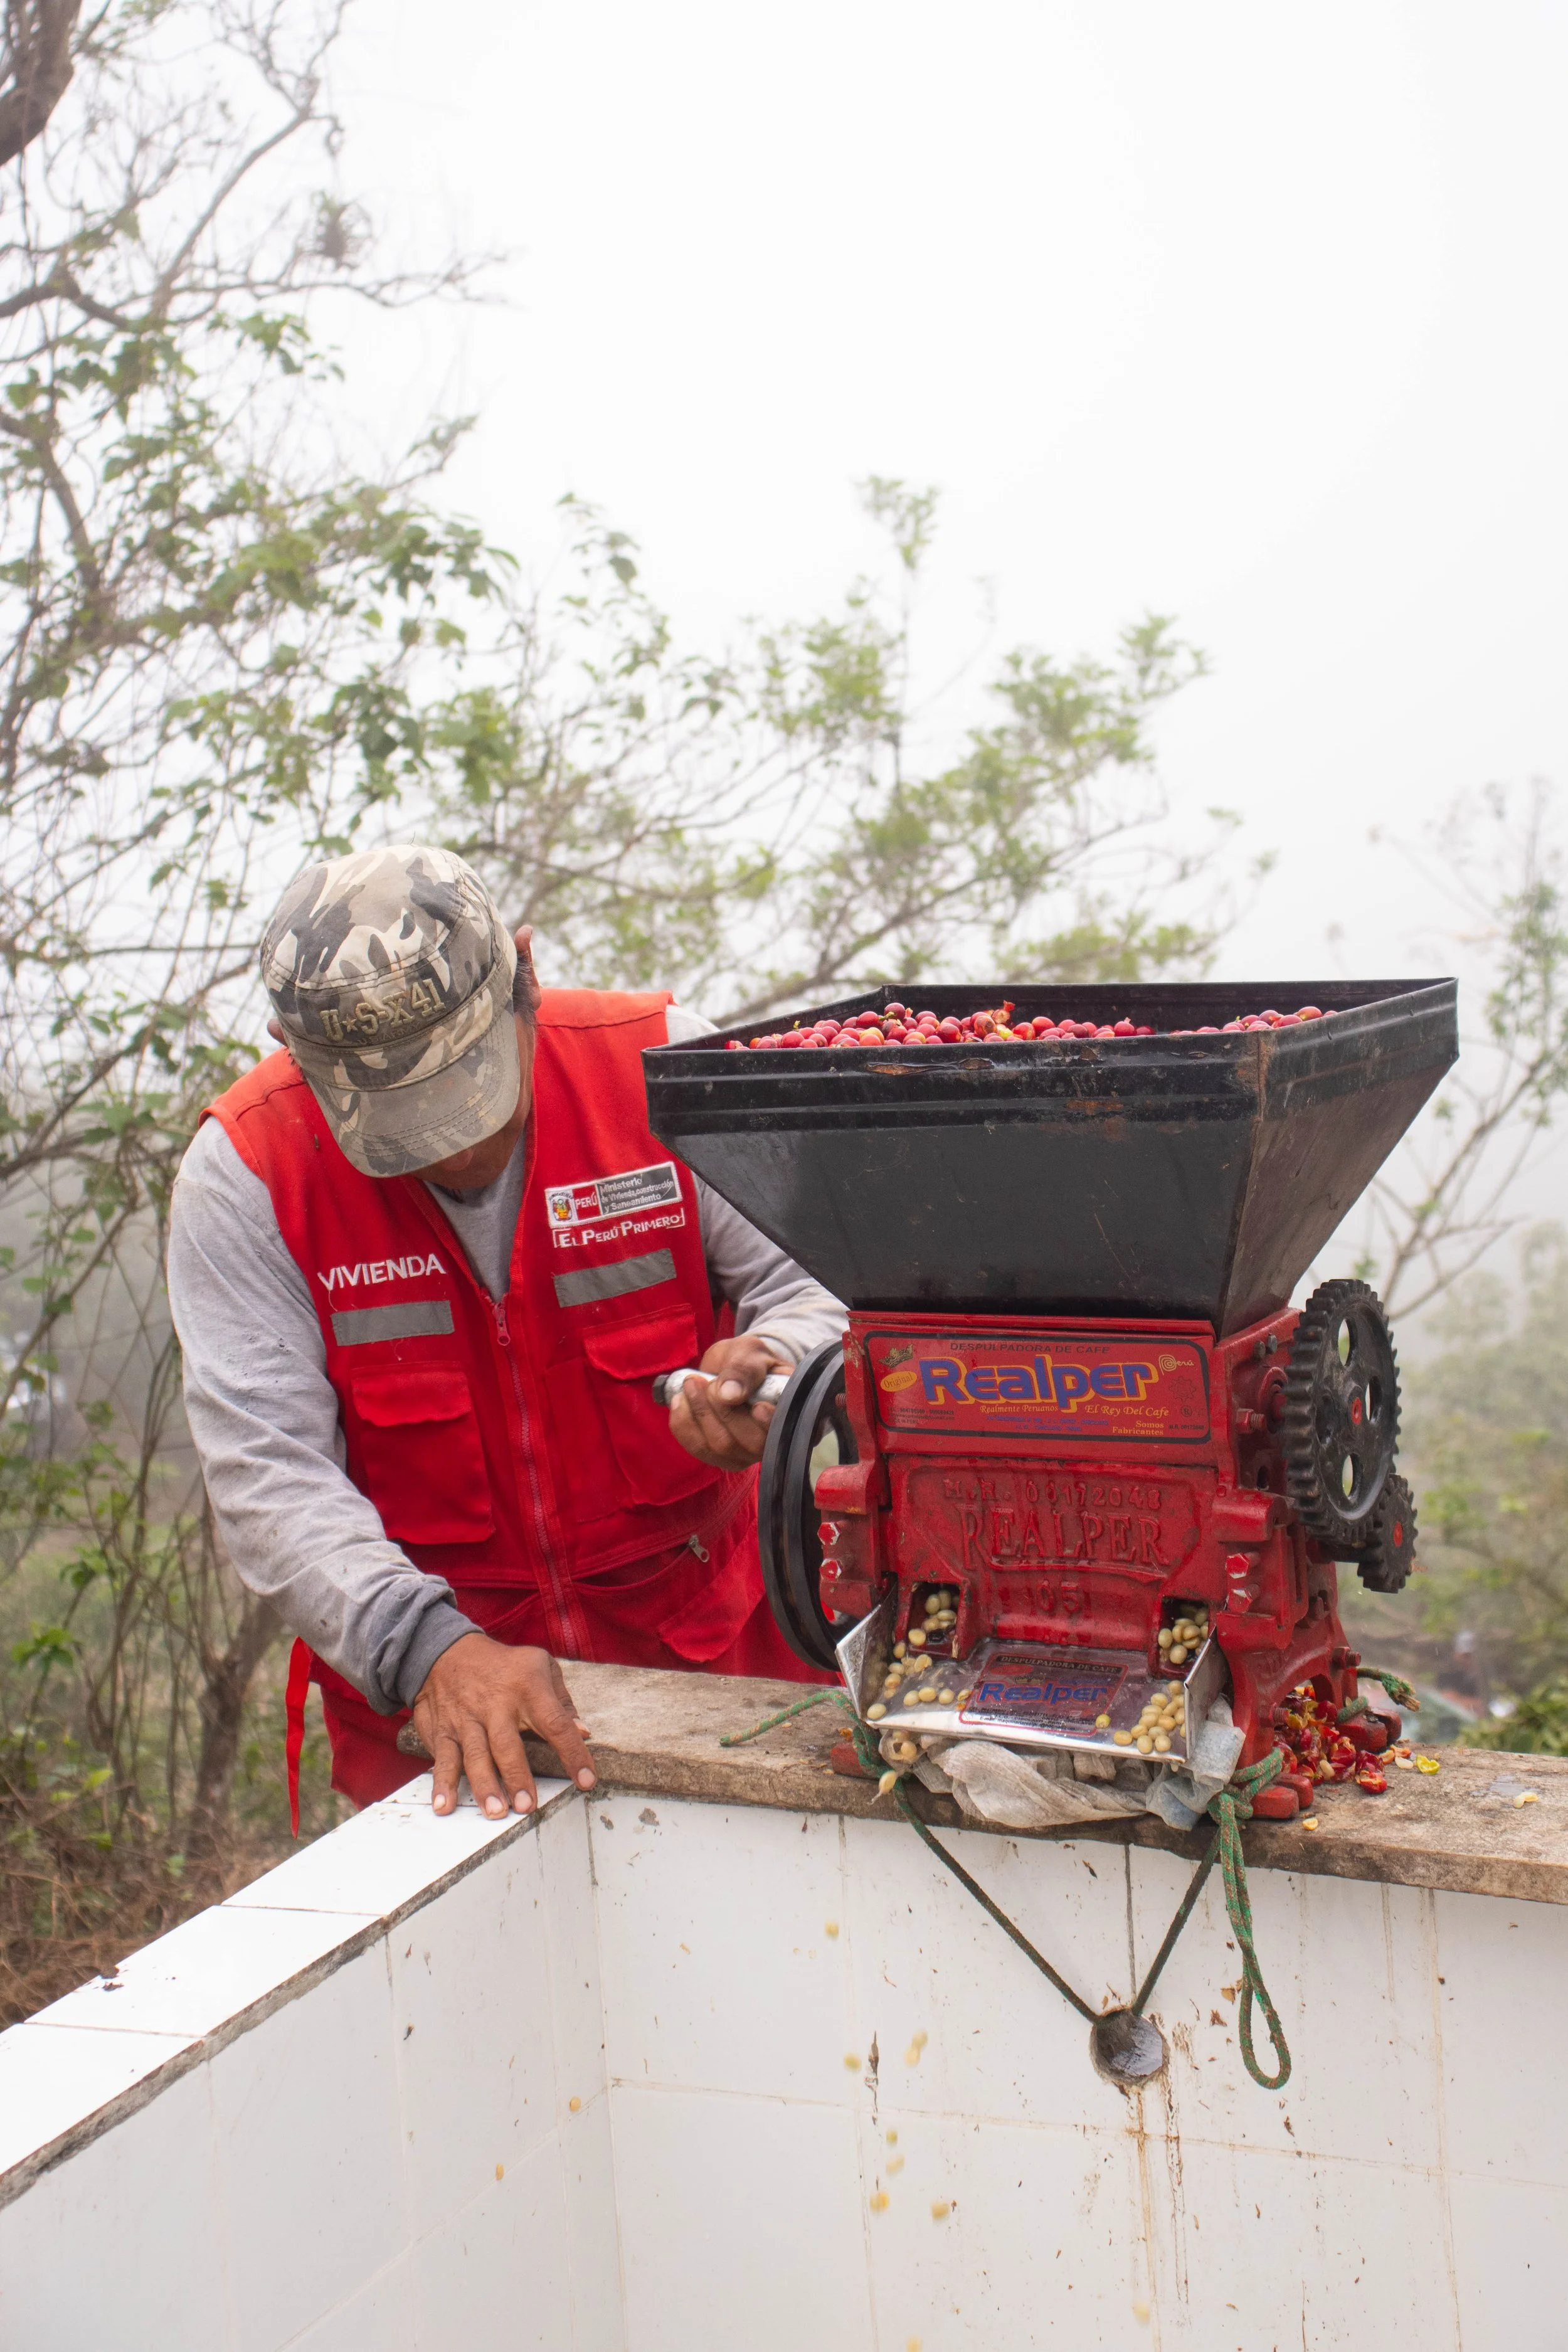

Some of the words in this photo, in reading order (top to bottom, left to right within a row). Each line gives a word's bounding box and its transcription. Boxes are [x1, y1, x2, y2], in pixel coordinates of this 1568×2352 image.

[599, 1177, 642, 1193] Ministerio
[575, 1192, 597, 1210] PERÚ
[604, 1205, 610, 1214] y
[612, 1194, 662, 1210] Saneamiento
[317, 1253, 447, 1291] VIVIENDA
[950, 1343, 1051, 1353] DESPULPADORA
[1055, 1345, 1073, 1353] DE
[1076, 1346, 1110, 1354] CAFE
[884, 1372, 913, 1389] Original
[919, 1354, 1159, 1414] Realper
[980, 1404, 1020, 1414] Realmente
[1022, 1404, 1058, 1412] Peruanos
[1084, 1404, 1099, 1414] El
[1101, 1405, 1121, 1417] Rey
[1123, 1406, 1145, 1416] Del
[1145, 1407, 1170, 1419] Cafe
[1112, 1426, 1164, 1436] Fabricantes
[956, 1503, 1171, 1570] REALPER
[1037, 1577, 1081, 1614] 05
[1000, 1656, 1075, 1670] DESPULPADORA
[1093, 1665, 1118, 1673] CAFE
[978, 1682, 1108, 1705] Realper
